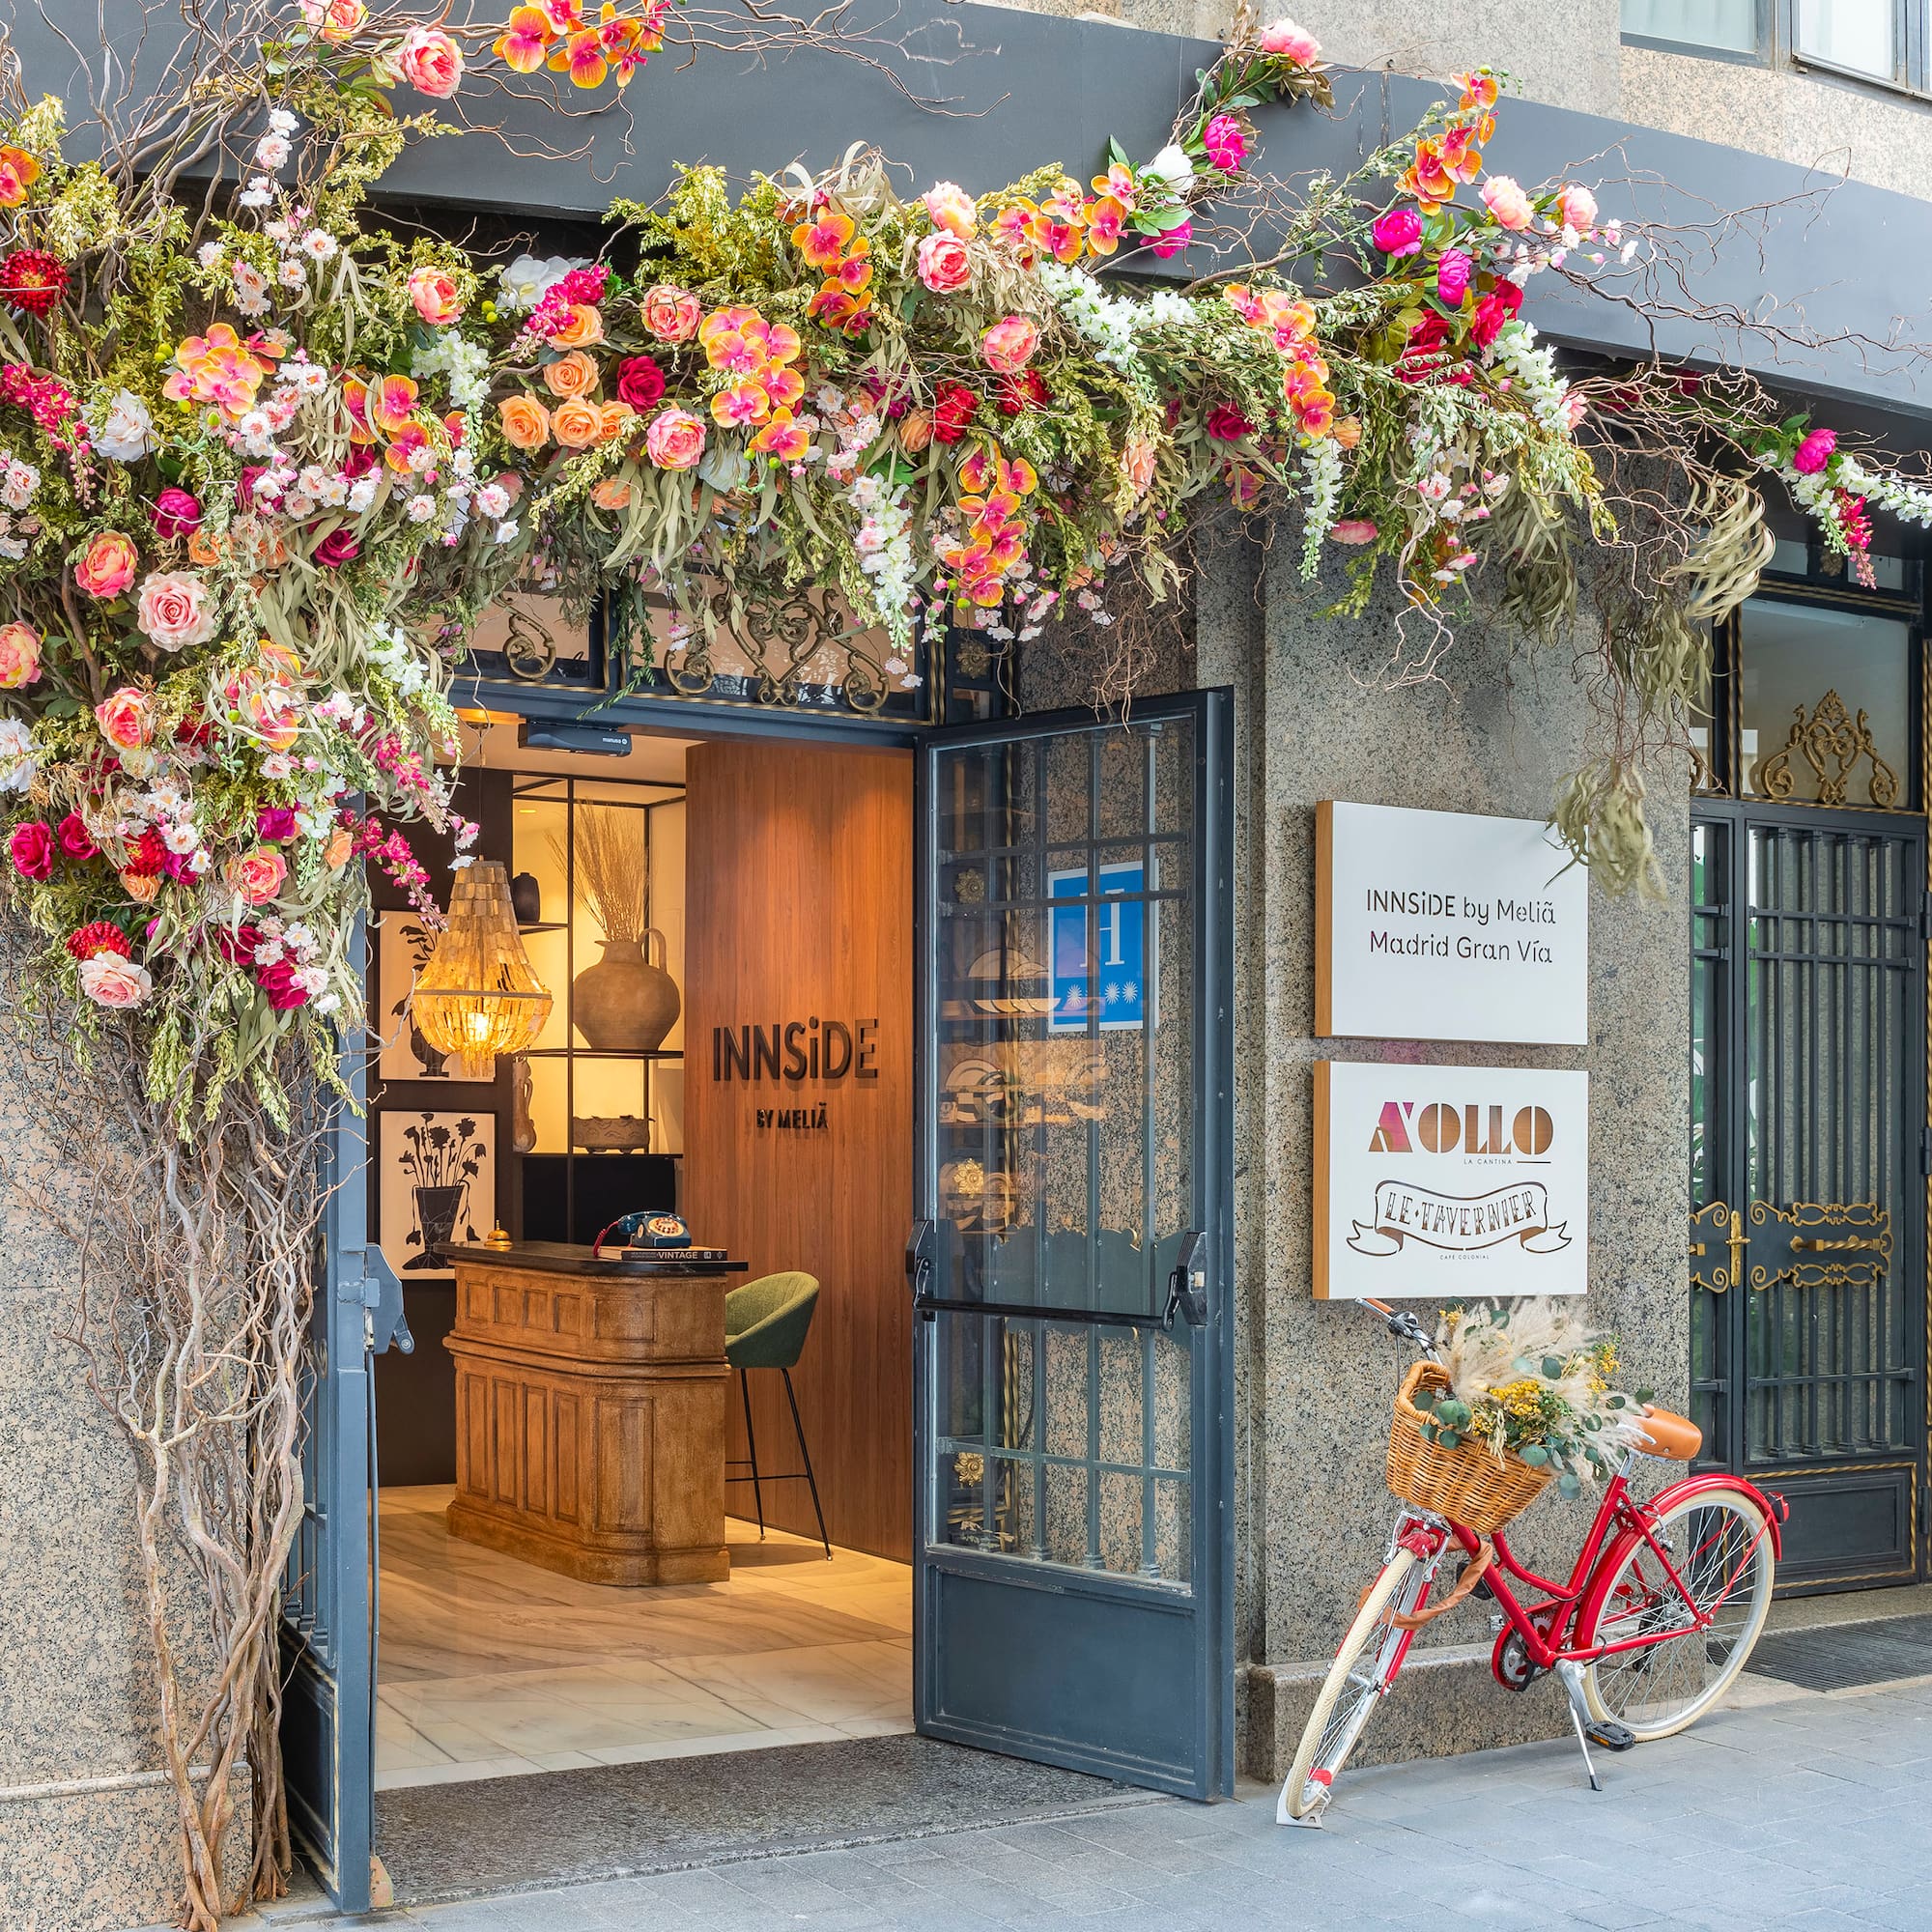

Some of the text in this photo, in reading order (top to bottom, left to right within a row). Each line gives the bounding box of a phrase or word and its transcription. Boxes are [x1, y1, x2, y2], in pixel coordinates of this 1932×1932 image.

[1367, 889, 1456, 917] INNSiDE
[1463, 896, 1490, 925] by
[1370, 931, 1552, 963] Madrid Gran Vía
[713, 1015, 878, 1082] INNSiDE
[757, 1109, 773, 1128] BY
[1384, 1190, 1537, 1236] LE TAVERNIER
[658, 1251, 697, 1260] VINTAGE
